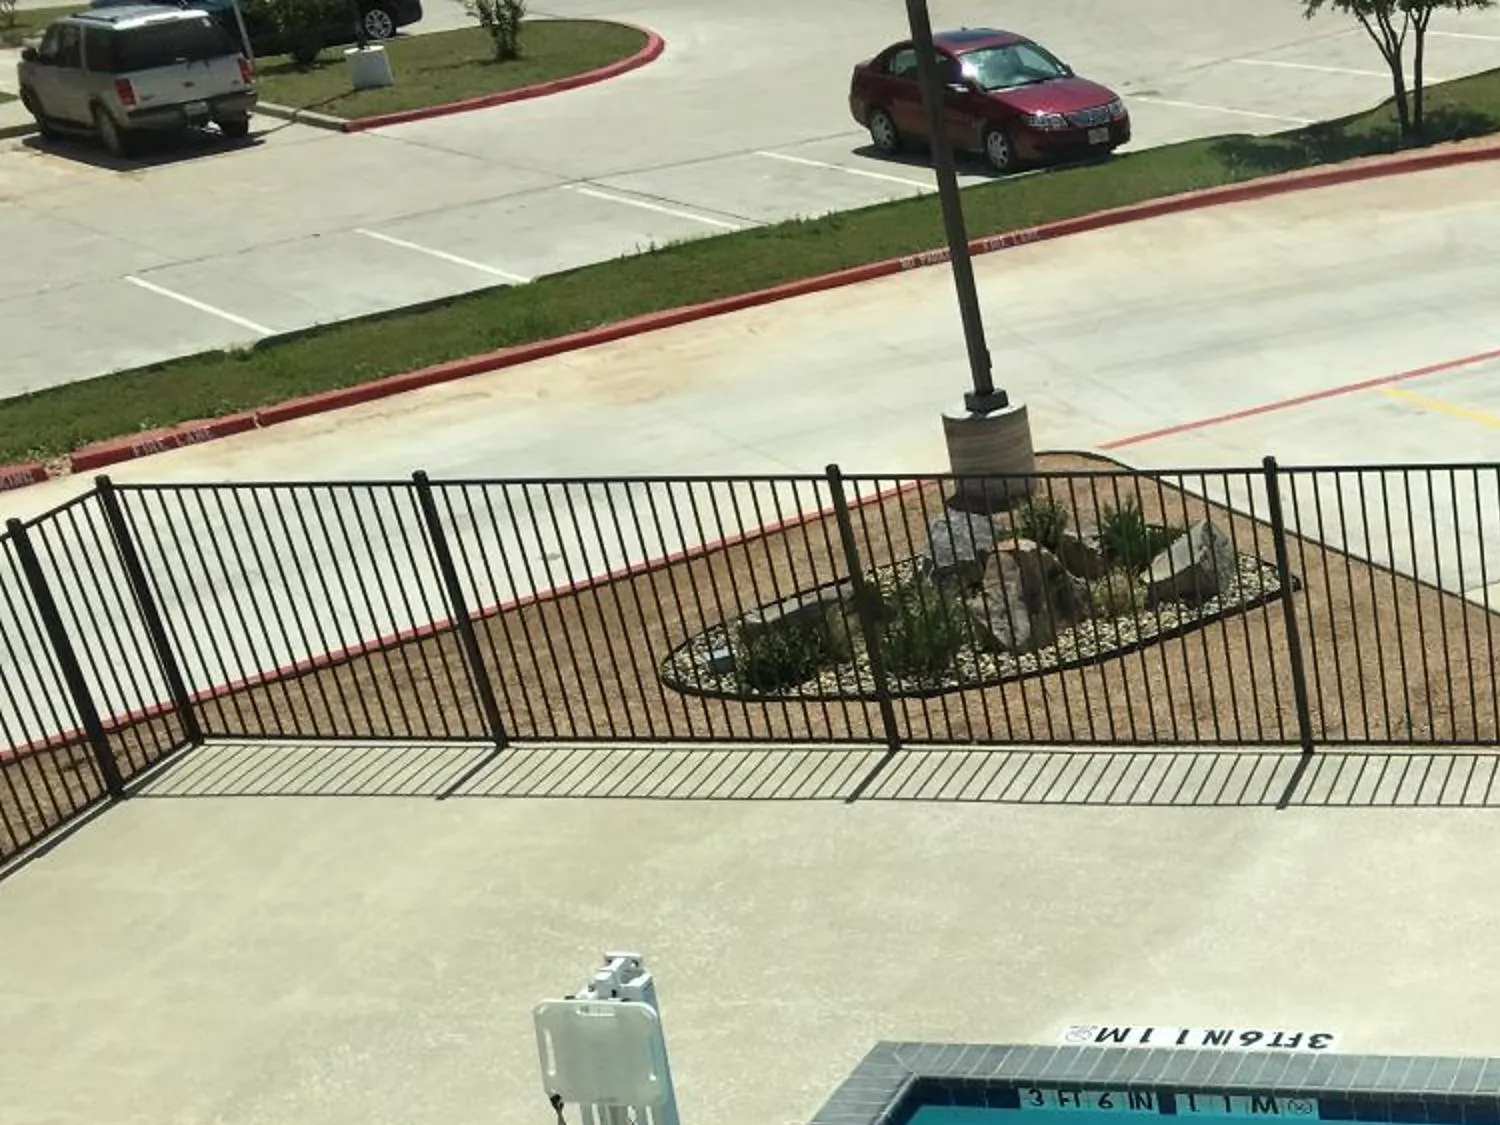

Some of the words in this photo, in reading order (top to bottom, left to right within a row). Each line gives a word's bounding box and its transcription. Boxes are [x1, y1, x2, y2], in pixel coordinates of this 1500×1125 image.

[1094, 1027, 1132, 1042] M
[1239, 1030, 1264, 1047] 6
[1307, 1033, 1334, 1049] 3
[1029, 1088, 1044, 1107] 3
[1058, 1089, 1082, 1109] FT
[1097, 1091, 1114, 1109] 6
[1127, 1090, 1153, 1111] IN
[1251, 1093, 1279, 1115] M
